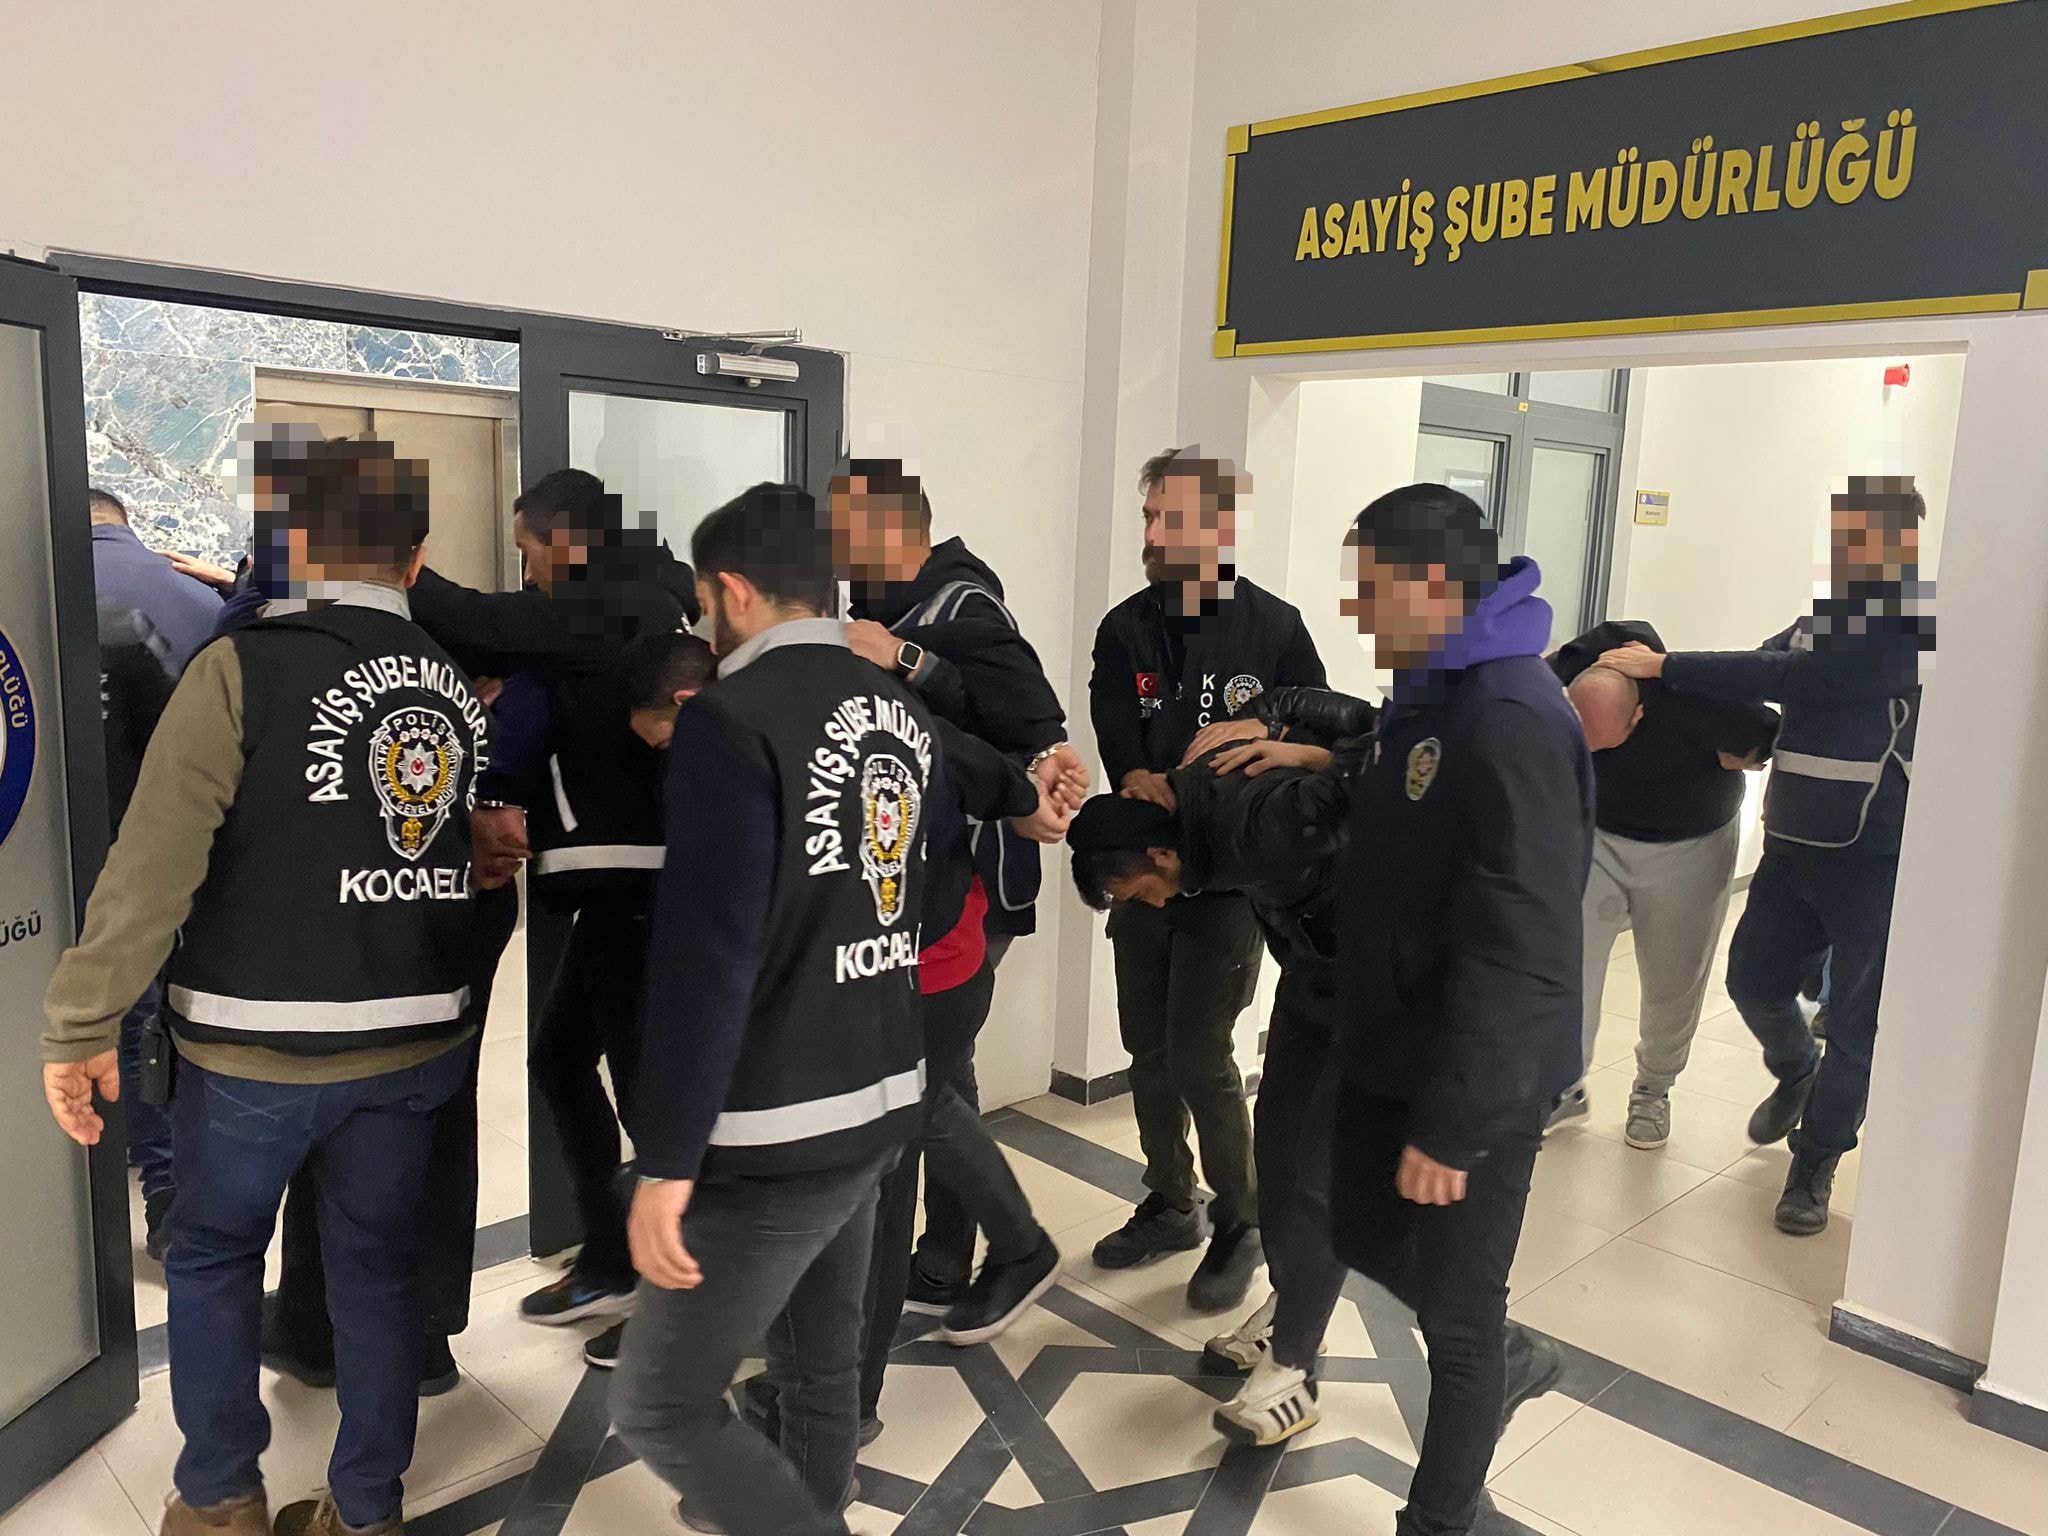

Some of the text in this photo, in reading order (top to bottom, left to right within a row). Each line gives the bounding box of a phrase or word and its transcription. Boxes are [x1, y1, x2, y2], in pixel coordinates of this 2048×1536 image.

[1295, 107, 1917, 266] ASAYİŞ ŞUBE MÜDÜRLÜĞÜ
[0, 650, 28, 728] LÜĞÜ
[392, 713, 447, 735] POLİS
[825, 696, 875, 760] ŞUBE
[305, 688, 363, 803] ASAYİŞ
[344, 655, 420, 708] ŞUBE
[805, 747, 856, 876] ASAYİŞ
[0, 909, 42, 948] ÜĞÜ
